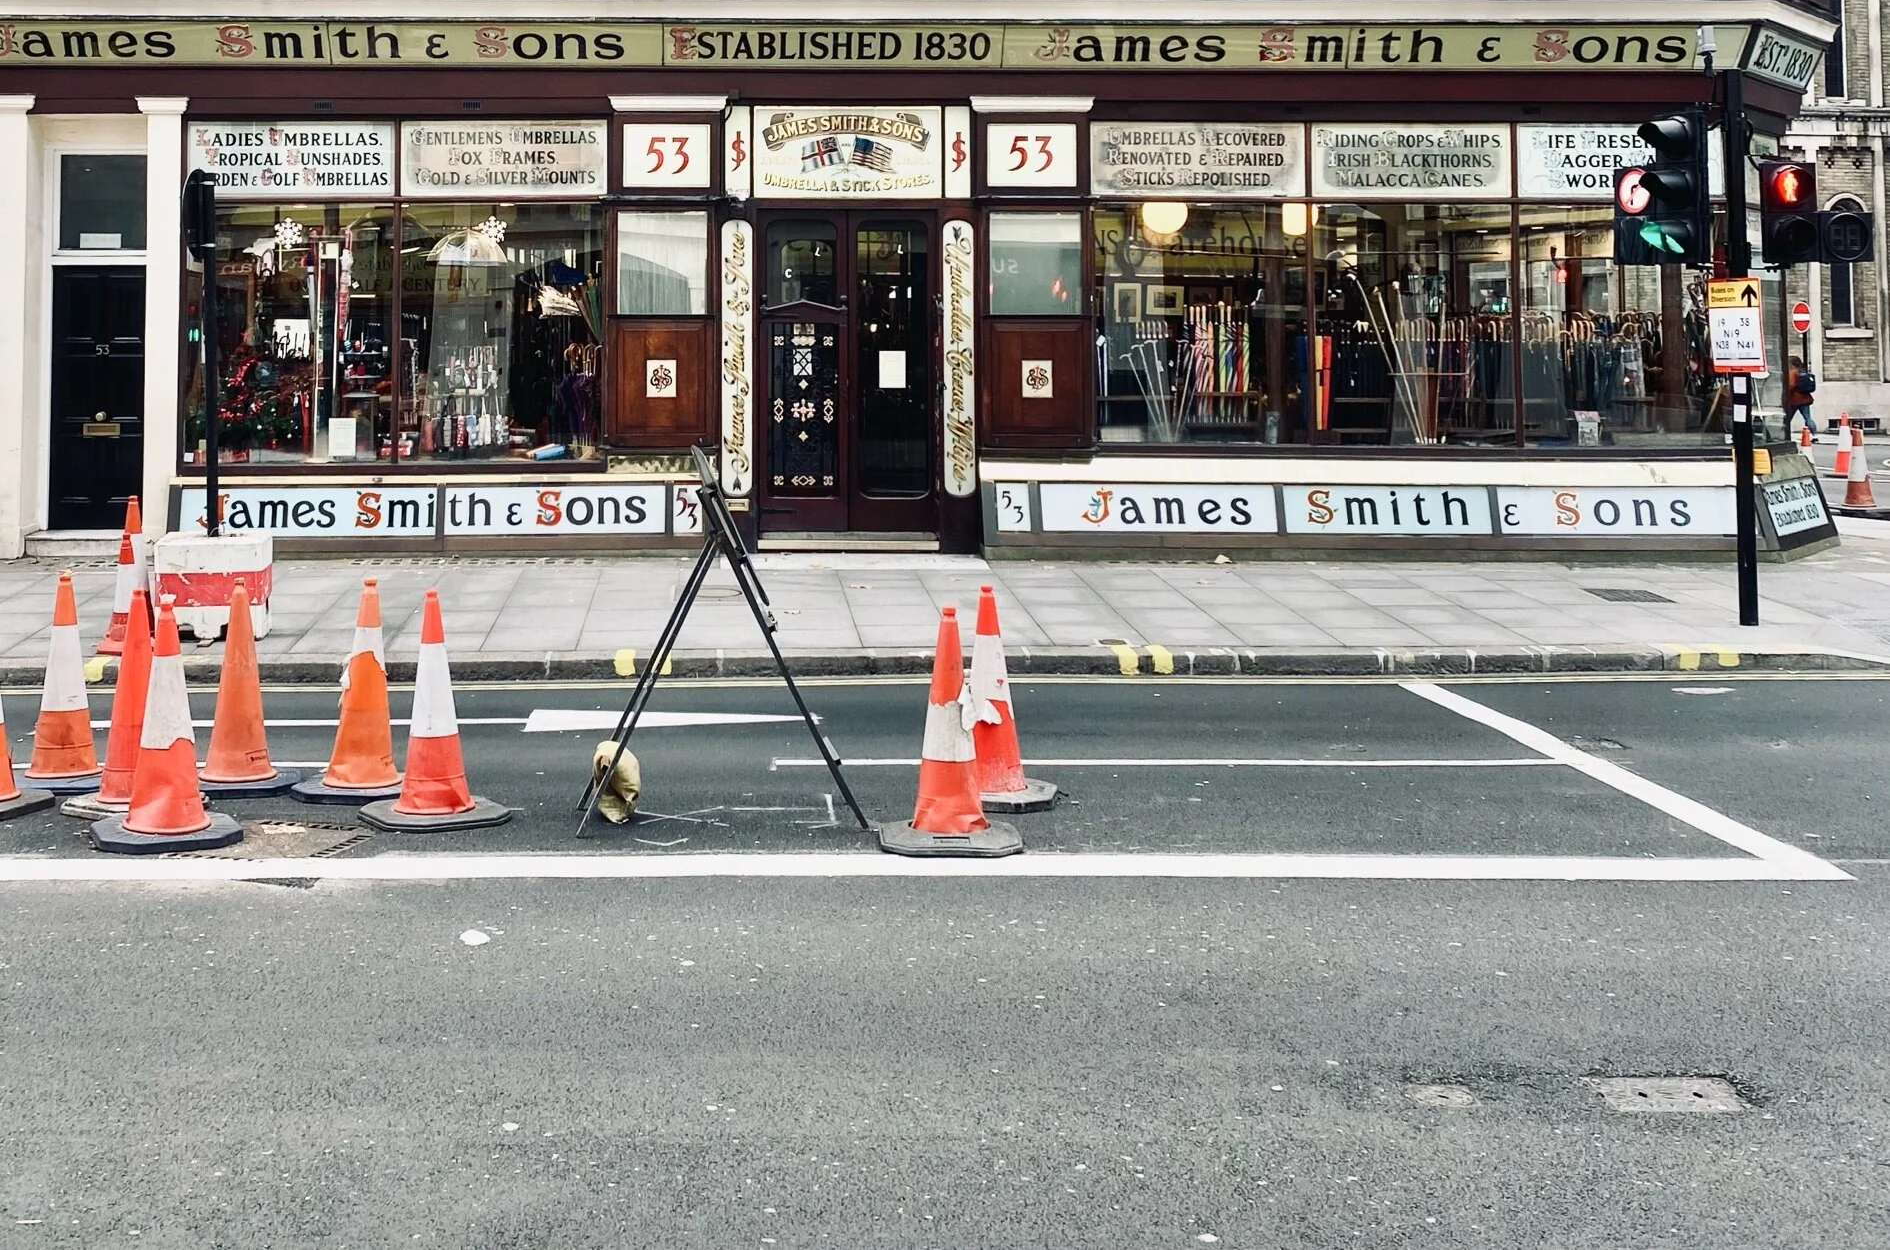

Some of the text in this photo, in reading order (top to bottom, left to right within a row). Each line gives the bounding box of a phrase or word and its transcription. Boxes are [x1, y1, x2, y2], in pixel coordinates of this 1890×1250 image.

[216, 23, 400, 59] Smith
[475, 26, 625, 60] Sons
[671, 27, 991, 60] ESTABLISHED 1830
[1034, 28, 1226, 62] James
[1259, 27, 1443, 64] Smith
[1532, 29, 1687, 64] Sons
[1783, 48, 1813, 82] 1830
[269, 127, 383, 147] UMBRELLAS.
[768, 119, 818, 143] JAMES
[1107, 128, 1196, 146] UMBRELLAS
[1317, 129, 1379, 148] RIDING
[1382, 130, 1434, 148] CROPS
[205, 148, 282, 166] TROPICAL
[646, 137, 690, 174] 53
[1008, 135, 1054, 174] 53
[1107, 148, 1192, 166] RENOVATED
[1328, 151, 1371, 168] IRISH
[213, 172, 249, 187] RDEN
[260, 168, 300, 187] GOLF
[415, 168, 460, 186] GOLD
[476, 168, 528, 186] SILVER
[531, 167, 596, 186] MOUNTS
[763, 171, 828, 192] UMBRELLA
[842, 179, 881, 192] STICK
[1121, 168, 1174, 187] STICKS
[1336, 170, 1421, 187] MALACCA
[96, 345, 110, 355] 53
[1737, 340, 1755, 349] N41
[355, 491, 491, 529] Smith
[535, 490, 647, 527] Sons
[676, 486, 698, 530] 53
[1001, 490, 1024, 524] 53
[1081, 488, 1253, 526] James
[1306, 489, 1470, 527] Smith
[1555, 491, 1693, 528] Sons
